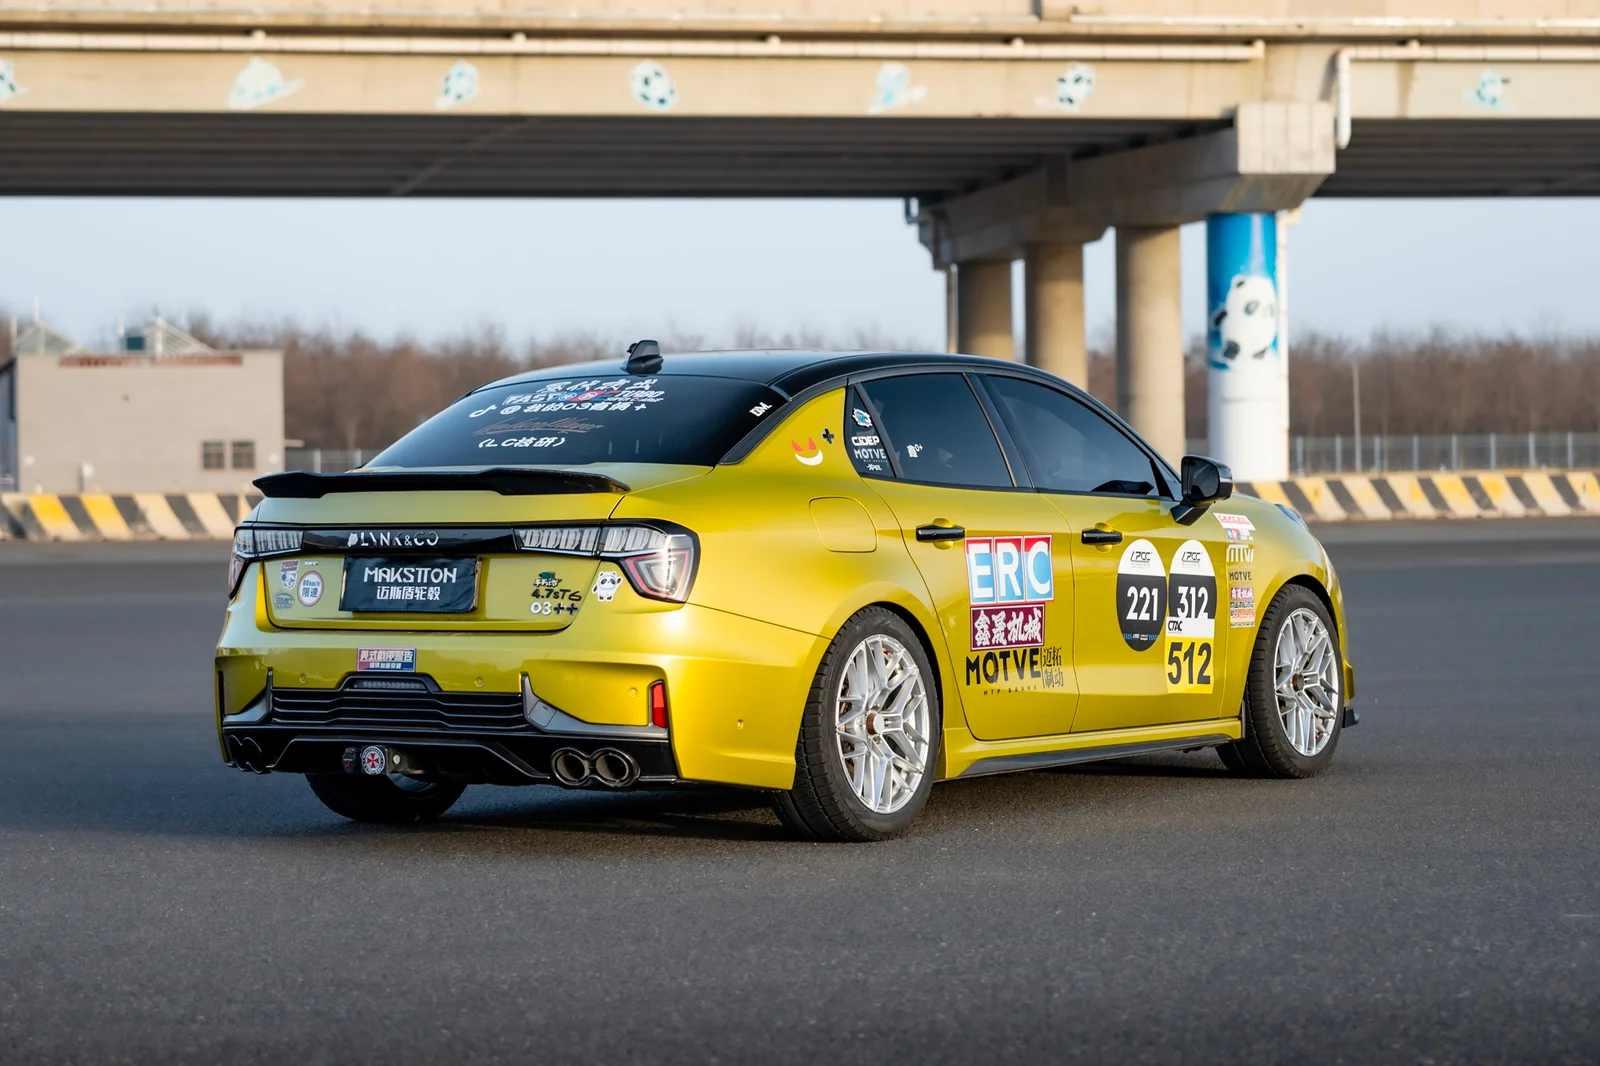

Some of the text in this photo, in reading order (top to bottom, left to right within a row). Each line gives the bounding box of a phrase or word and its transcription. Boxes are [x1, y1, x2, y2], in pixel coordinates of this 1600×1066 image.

[853, 448, 887, 459] MOTVE
[967, 540, 1051, 599] ERC
[1229, 571, 1252, 581] MOTVE
[1126, 586, 1159, 621] 221
[1177, 586, 1209, 619] 312
[966, 648, 1041, 686] MOTVE
[1168, 642, 1212, 685] 512
